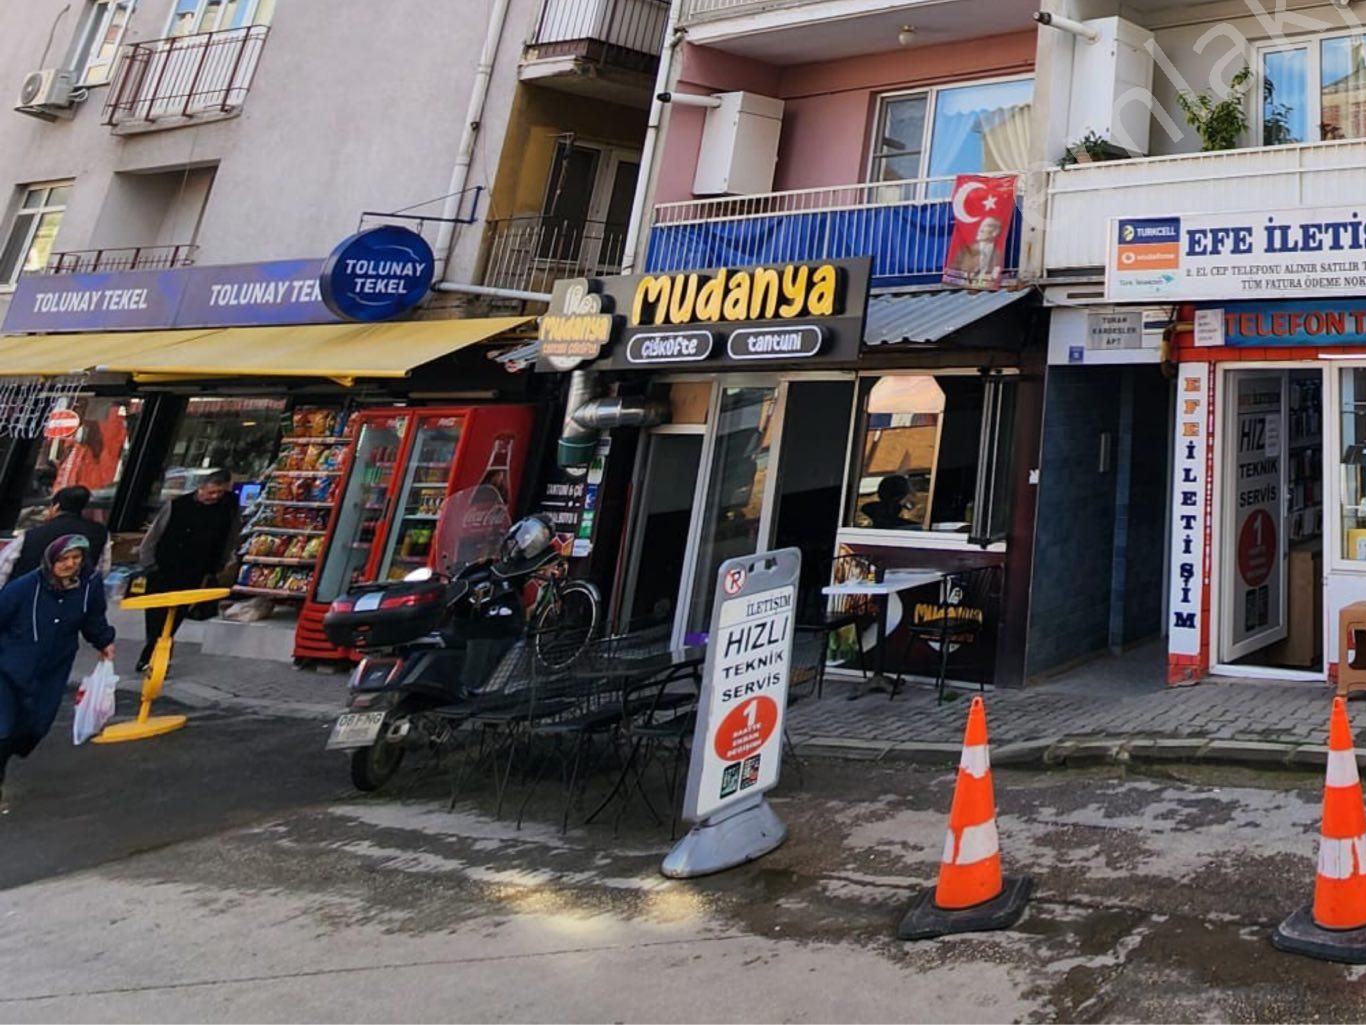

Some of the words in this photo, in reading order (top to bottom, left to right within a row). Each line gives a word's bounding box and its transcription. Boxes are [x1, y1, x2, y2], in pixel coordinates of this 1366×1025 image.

[1136, 226, 1176, 237] TURKCELL
[1186, 226, 1253, 257] EFE
[346, 260, 426, 276] TOLUNAY
[1196, 267, 1209, 277] EL
[1210, 266, 1229, 276] CEP
[1231, 264, 1282, 276] TELEFONU
[1283, 263, 1318, 274] ALINIR
[209, 281, 286, 306] TOLUNAY
[290, 279, 322, 303] TEK
[354, 278, 408, 294] TEKEL
[1241, 277, 1263, 290] TÜM
[1265, 278, 1303, 290] FATURA
[1304, 275, 1342, 289] ÖDEME
[33, 290, 101, 313] TOLUNAY
[102, 288, 148, 311] TEKEL
[1225, 311, 1346, 337] TELEFON
[747, 332, 802, 353] tantuni
[1182, 377, 1201, 437] EFE
[1239, 483, 1277, 508] SERVİS
[745, 594, 792, 617] İLETİŞİM
[724, 616, 789, 659] HIZLI
[722, 650, 784, 680] TEKNİK
[721, 672, 781, 703] SERVİS
[743, 699, 759, 728] 1
